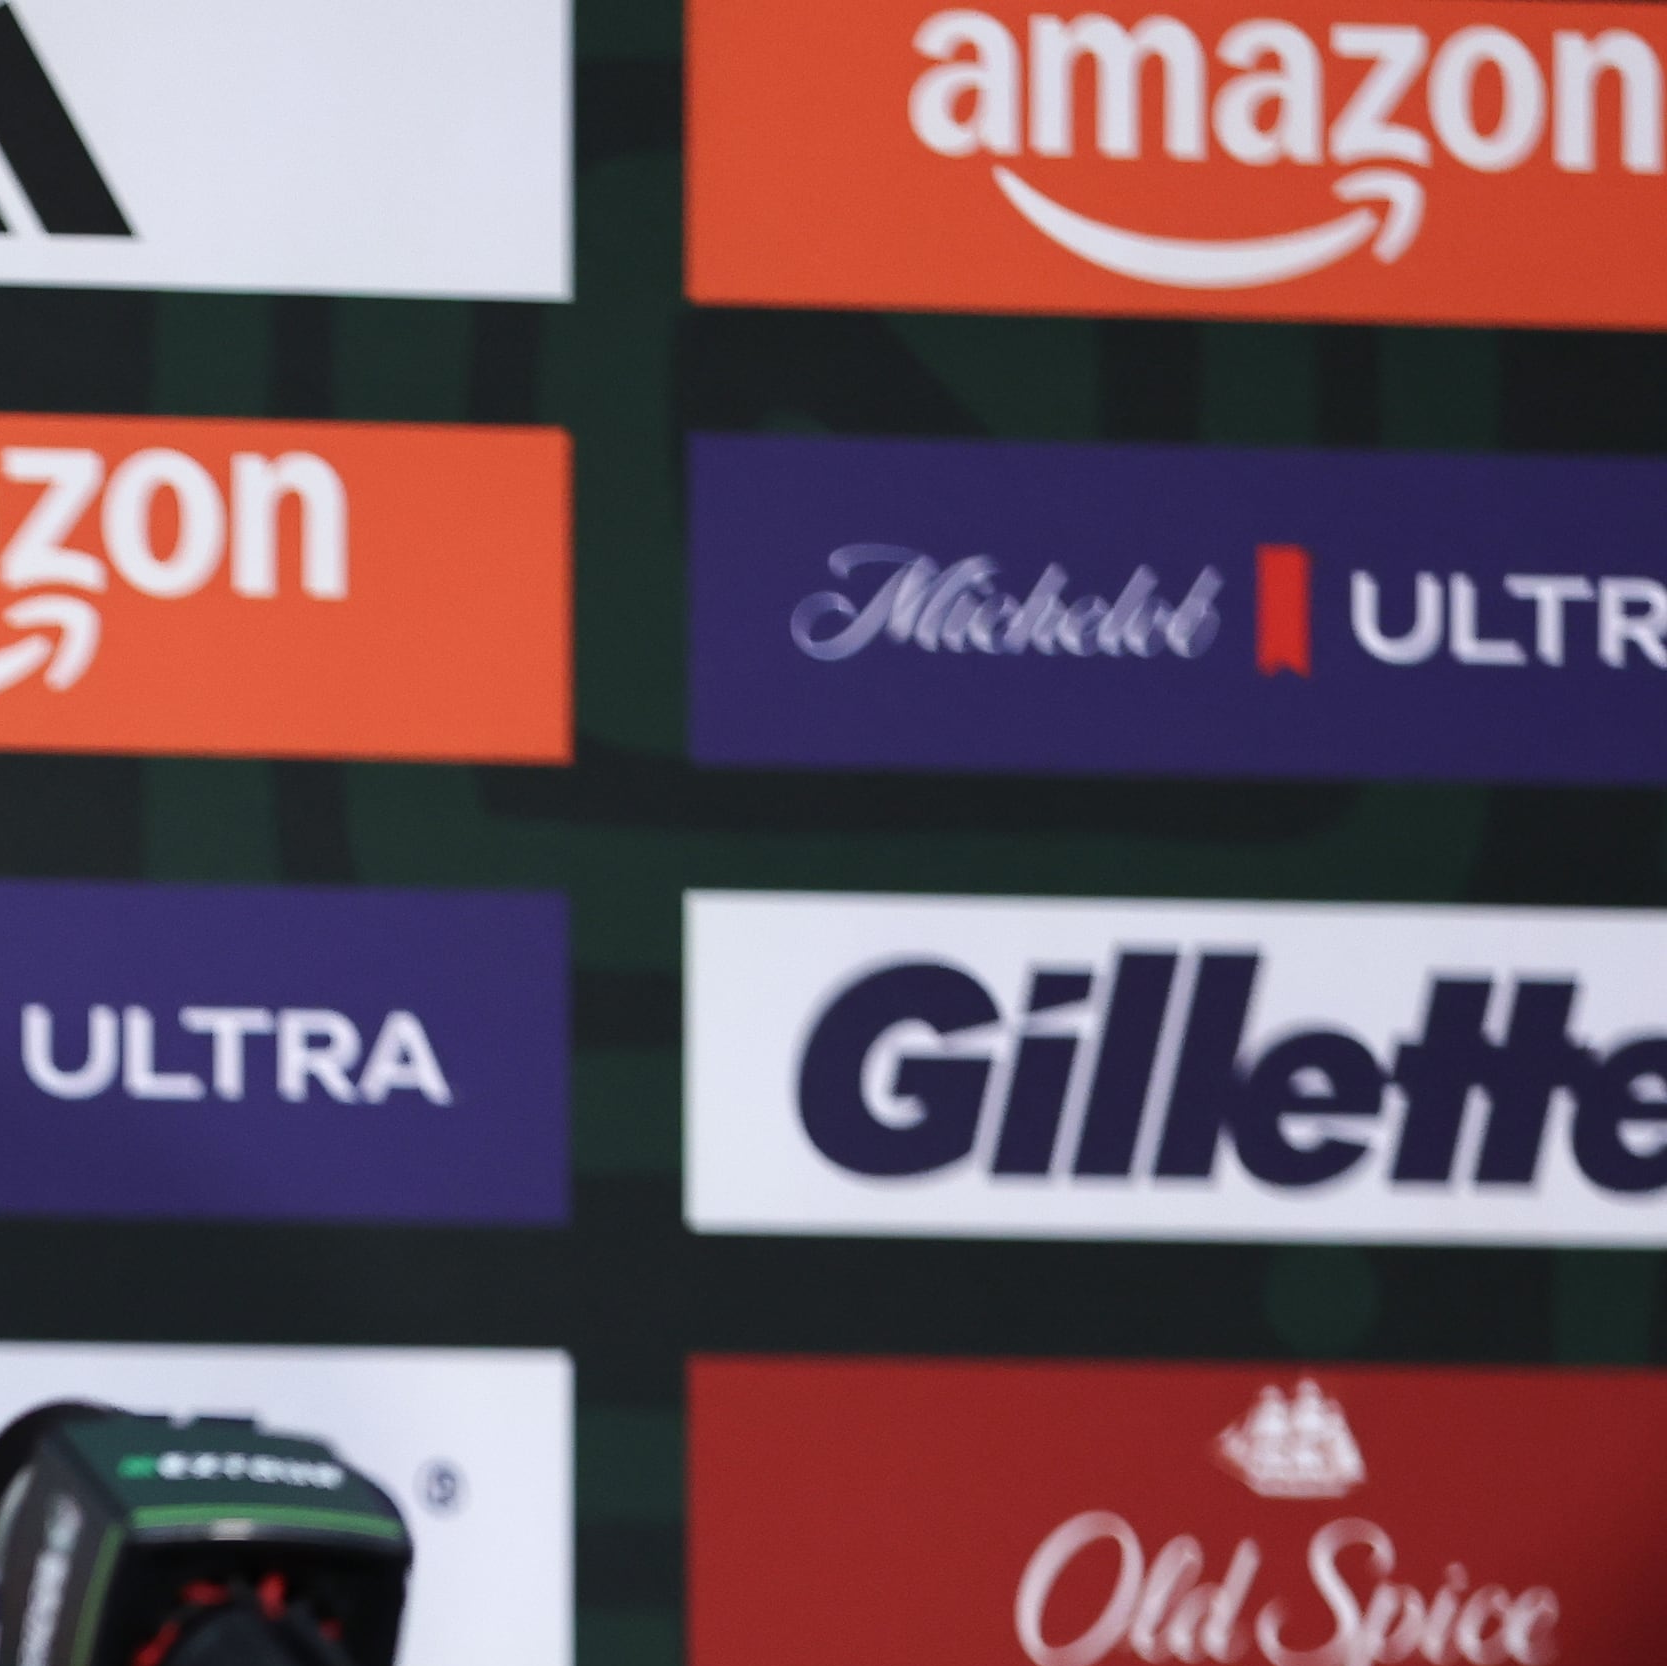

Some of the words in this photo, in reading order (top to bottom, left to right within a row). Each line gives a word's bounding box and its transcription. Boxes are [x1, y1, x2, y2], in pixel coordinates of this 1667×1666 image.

[906, 7, 1665, 174] amazon
[20, 1003, 453, 1106] ULTRA
[791, 944, 1667, 1200] Gillette
